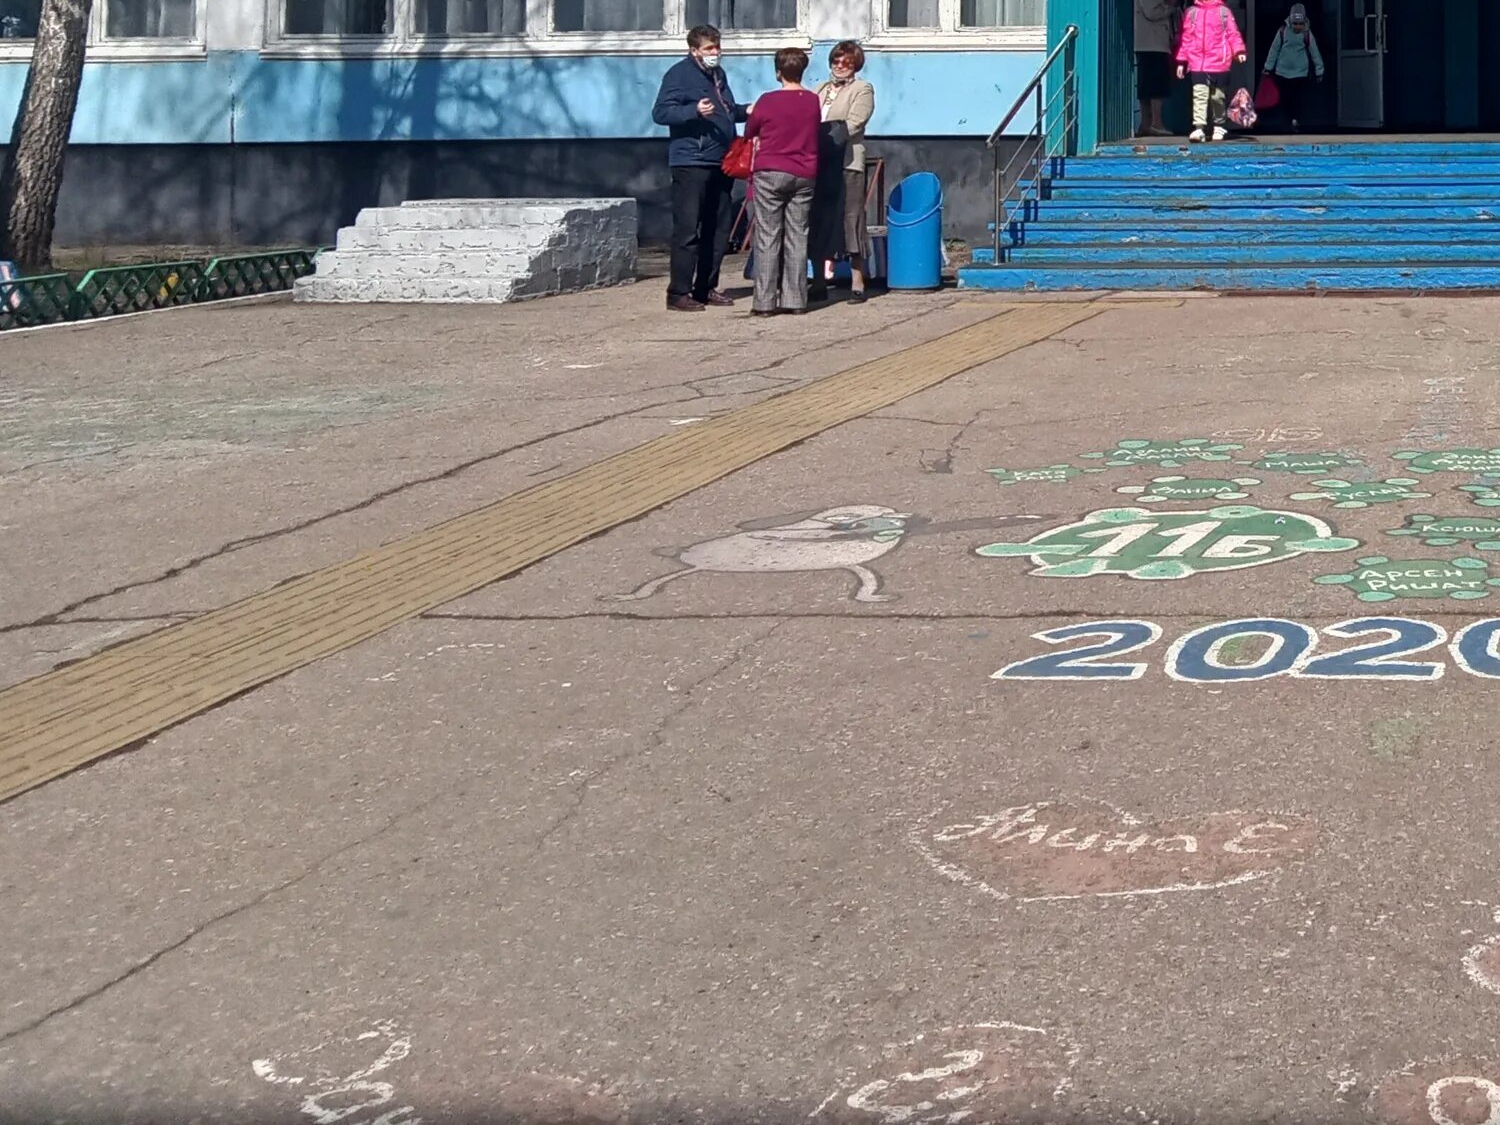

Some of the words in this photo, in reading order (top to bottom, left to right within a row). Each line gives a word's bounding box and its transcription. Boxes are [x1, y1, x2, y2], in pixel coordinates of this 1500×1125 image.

[1265, 459, 1340, 468] МАША
[1320, 486, 1410, 500] РУСЛАН
[1075, 520, 1281, 558] 11Б
